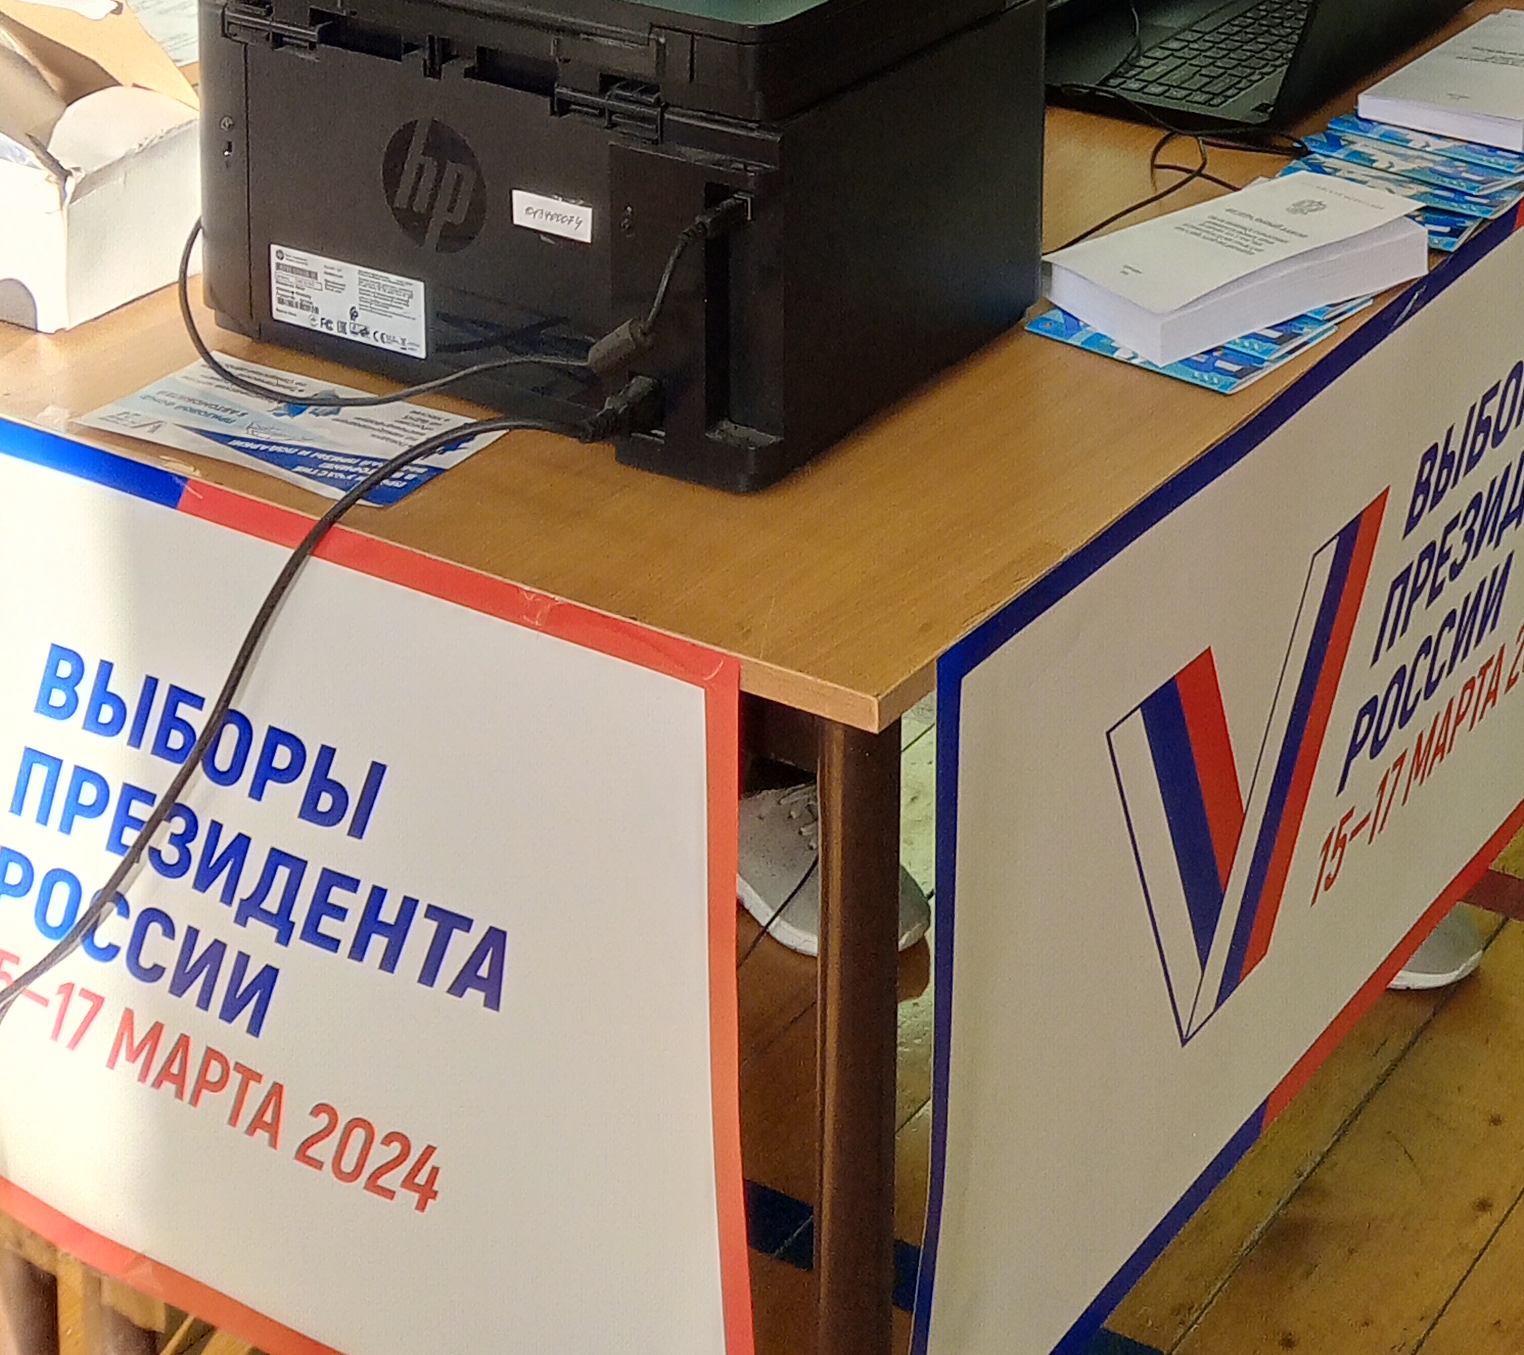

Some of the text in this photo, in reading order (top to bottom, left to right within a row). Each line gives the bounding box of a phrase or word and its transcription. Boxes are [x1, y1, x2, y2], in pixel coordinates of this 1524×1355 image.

[34, 643, 388, 840] ВЫБОРЫ
[1336, 549, 1516, 798] РОССИИ
[1401, 642, 1506, 807] МАРТА
[0, 845, 281, 1039] РОССИИ
[9, 745, 510, 1013] ПРЕЗИДЕНТА
[105, 1006, 287, 1151] МАРТА
[293, 1101, 442, 1215] 2024
